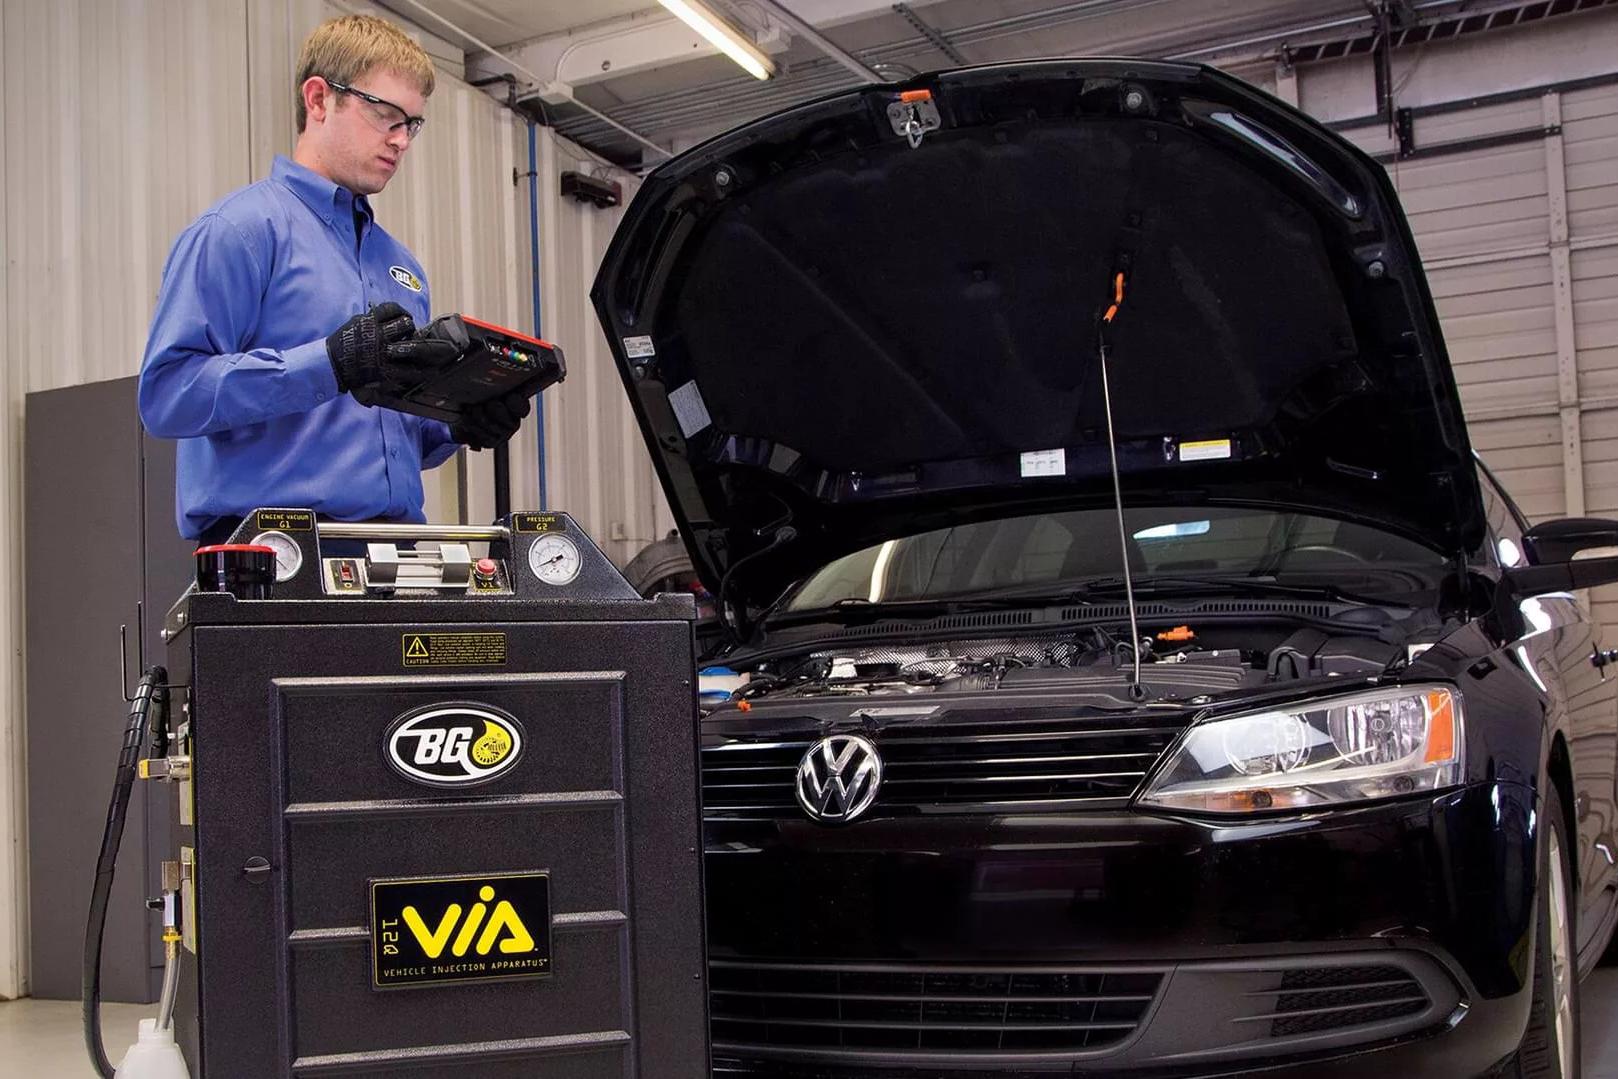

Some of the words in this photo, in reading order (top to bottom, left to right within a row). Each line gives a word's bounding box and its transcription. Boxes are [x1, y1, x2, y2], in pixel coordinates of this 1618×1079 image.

[279, 521, 291, 529] G1
[536, 523, 548, 531] G2
[410, 726, 474, 766] BG
[382, 918, 399, 956] 12Q
[383, 966, 427, 978] VEHICLE
[432, 963, 486, 975] INJECTION
